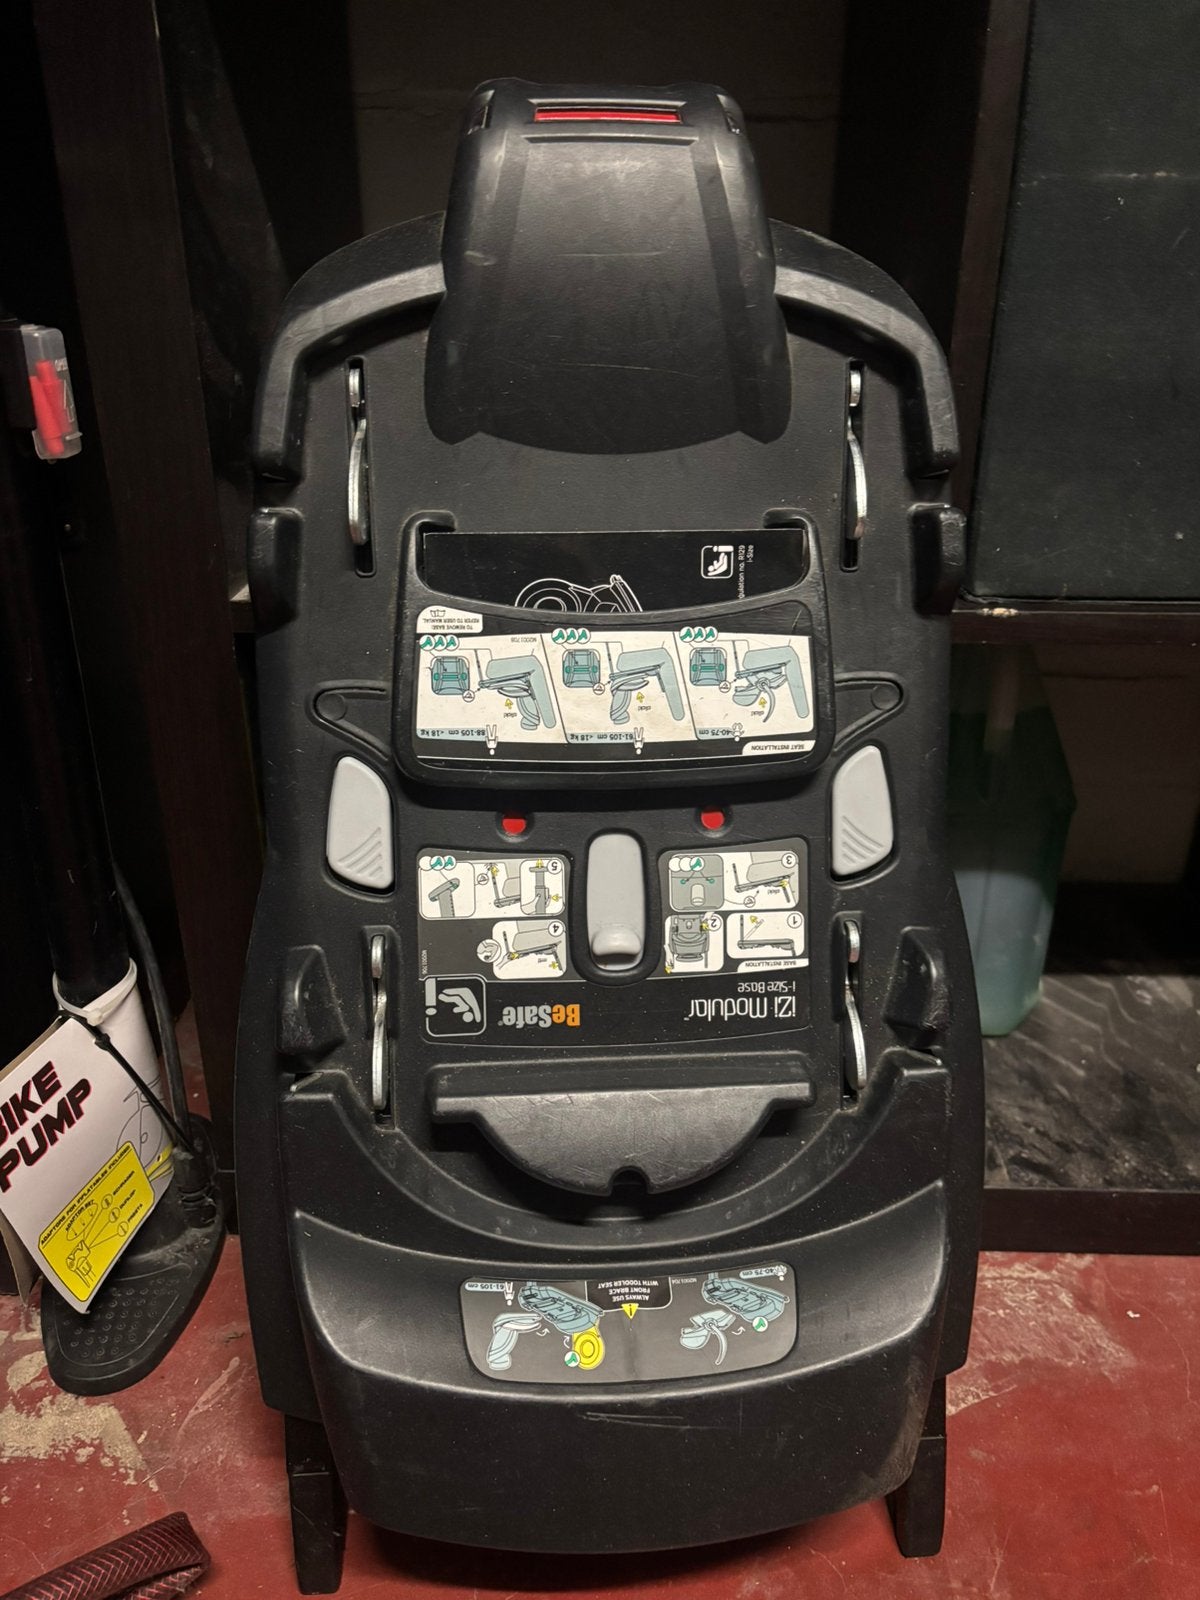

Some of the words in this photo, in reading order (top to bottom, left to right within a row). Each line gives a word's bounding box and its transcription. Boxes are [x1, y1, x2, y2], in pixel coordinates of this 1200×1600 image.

[786, 856, 792, 865] 3
[552, 862, 558, 871] 5
[710, 918, 718, 928] 2
[792, 916, 798, 925] 1
[553, 924, 560, 934] 4
[745, 960, 782, 968] INSTALLATION
[737, 982, 766, 993] Base
[767, 980, 796, 992] i-Size
[774, 996, 796, 1018] iZi
[0, 1060, 62, 1147] IKE
[0, 1078, 92, 1193] PUMP
[41, 1216, 66, 1245] ADAPTORS
[66, 1204, 76, 1216] FOR
[77, 1170, 108, 1204] INFLATABLES
[108, 1145, 130, 1170] INCLUDED
[66, 1207, 84, 1232] ADAPTOR
[754, 1268, 774, 1276] 40-75
